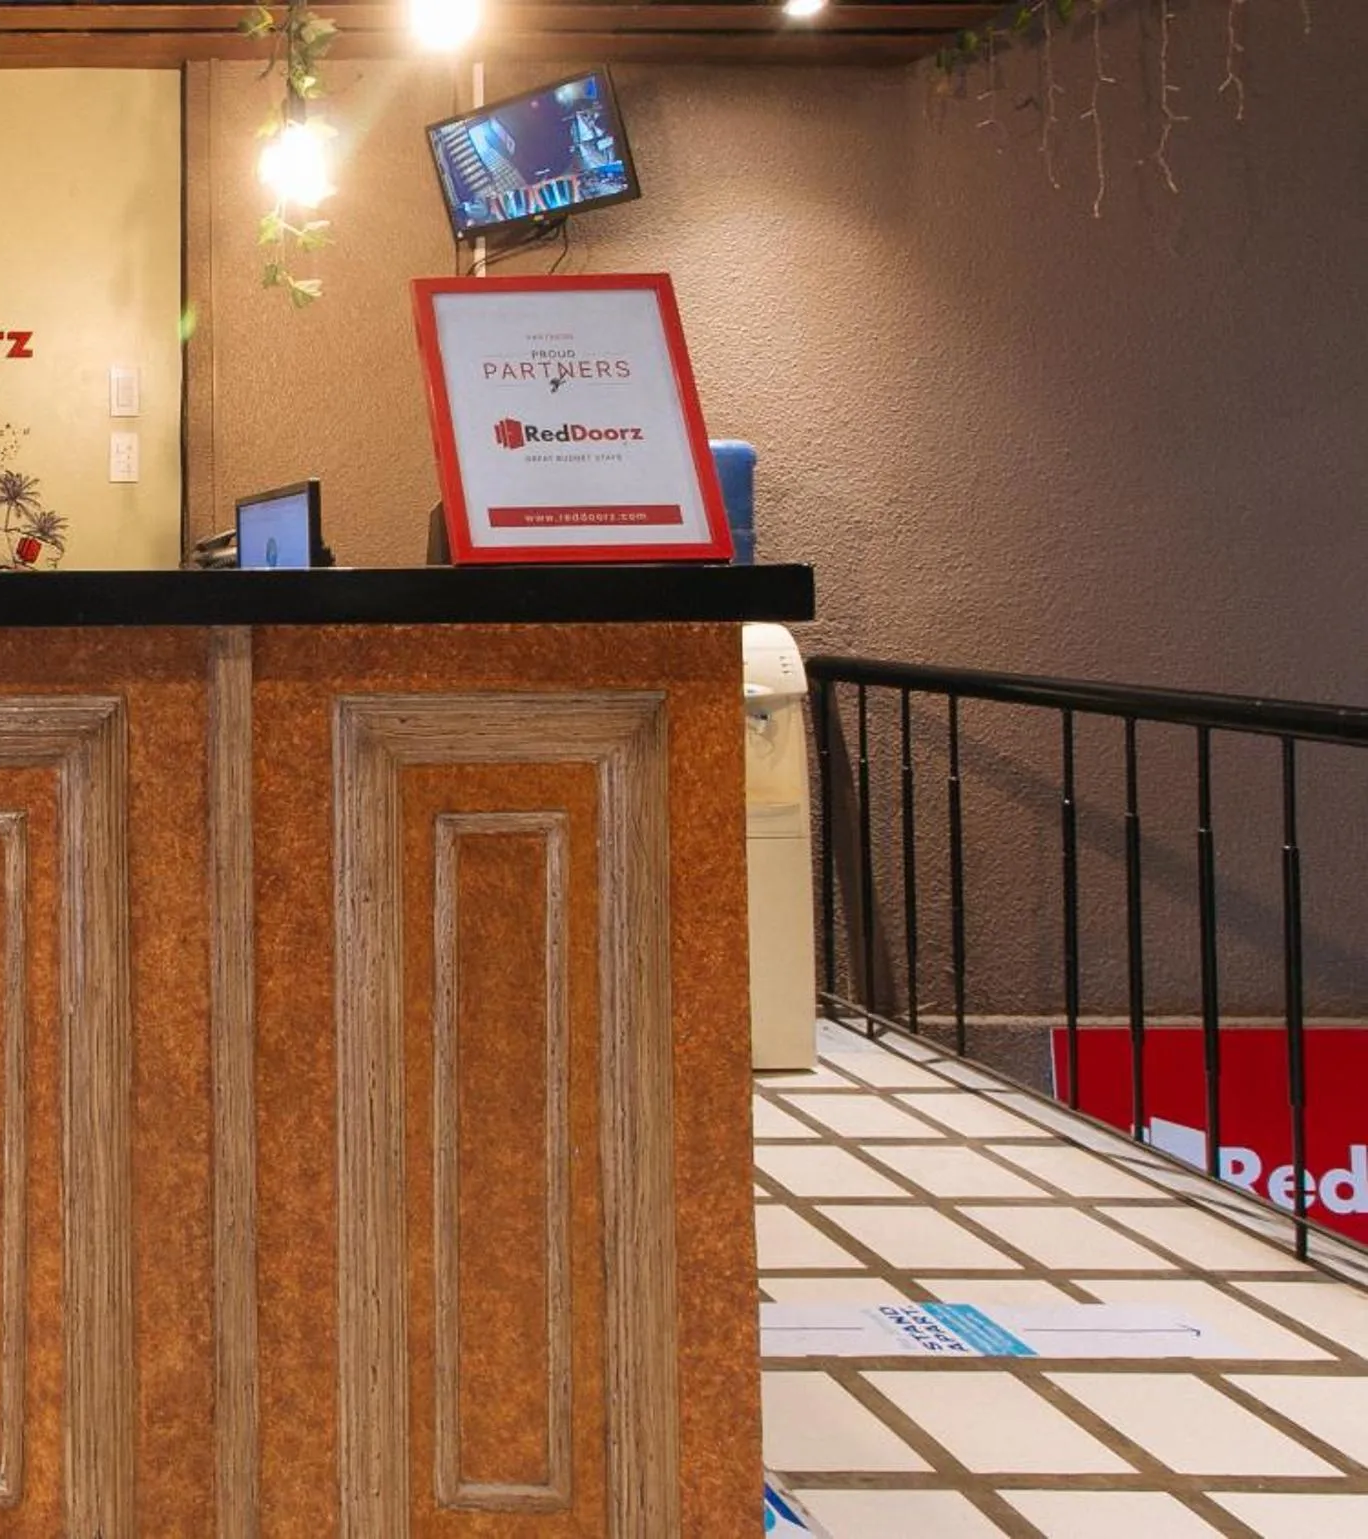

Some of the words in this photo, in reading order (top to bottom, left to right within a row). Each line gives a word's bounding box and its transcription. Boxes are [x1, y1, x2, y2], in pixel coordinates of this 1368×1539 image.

[532, 349, 576, 358] PROUD
[484, 360, 631, 380] PARTNERS
[525, 424, 644, 443] RedDoorz
[524, 512, 647, 523] www.reddoorz.com
